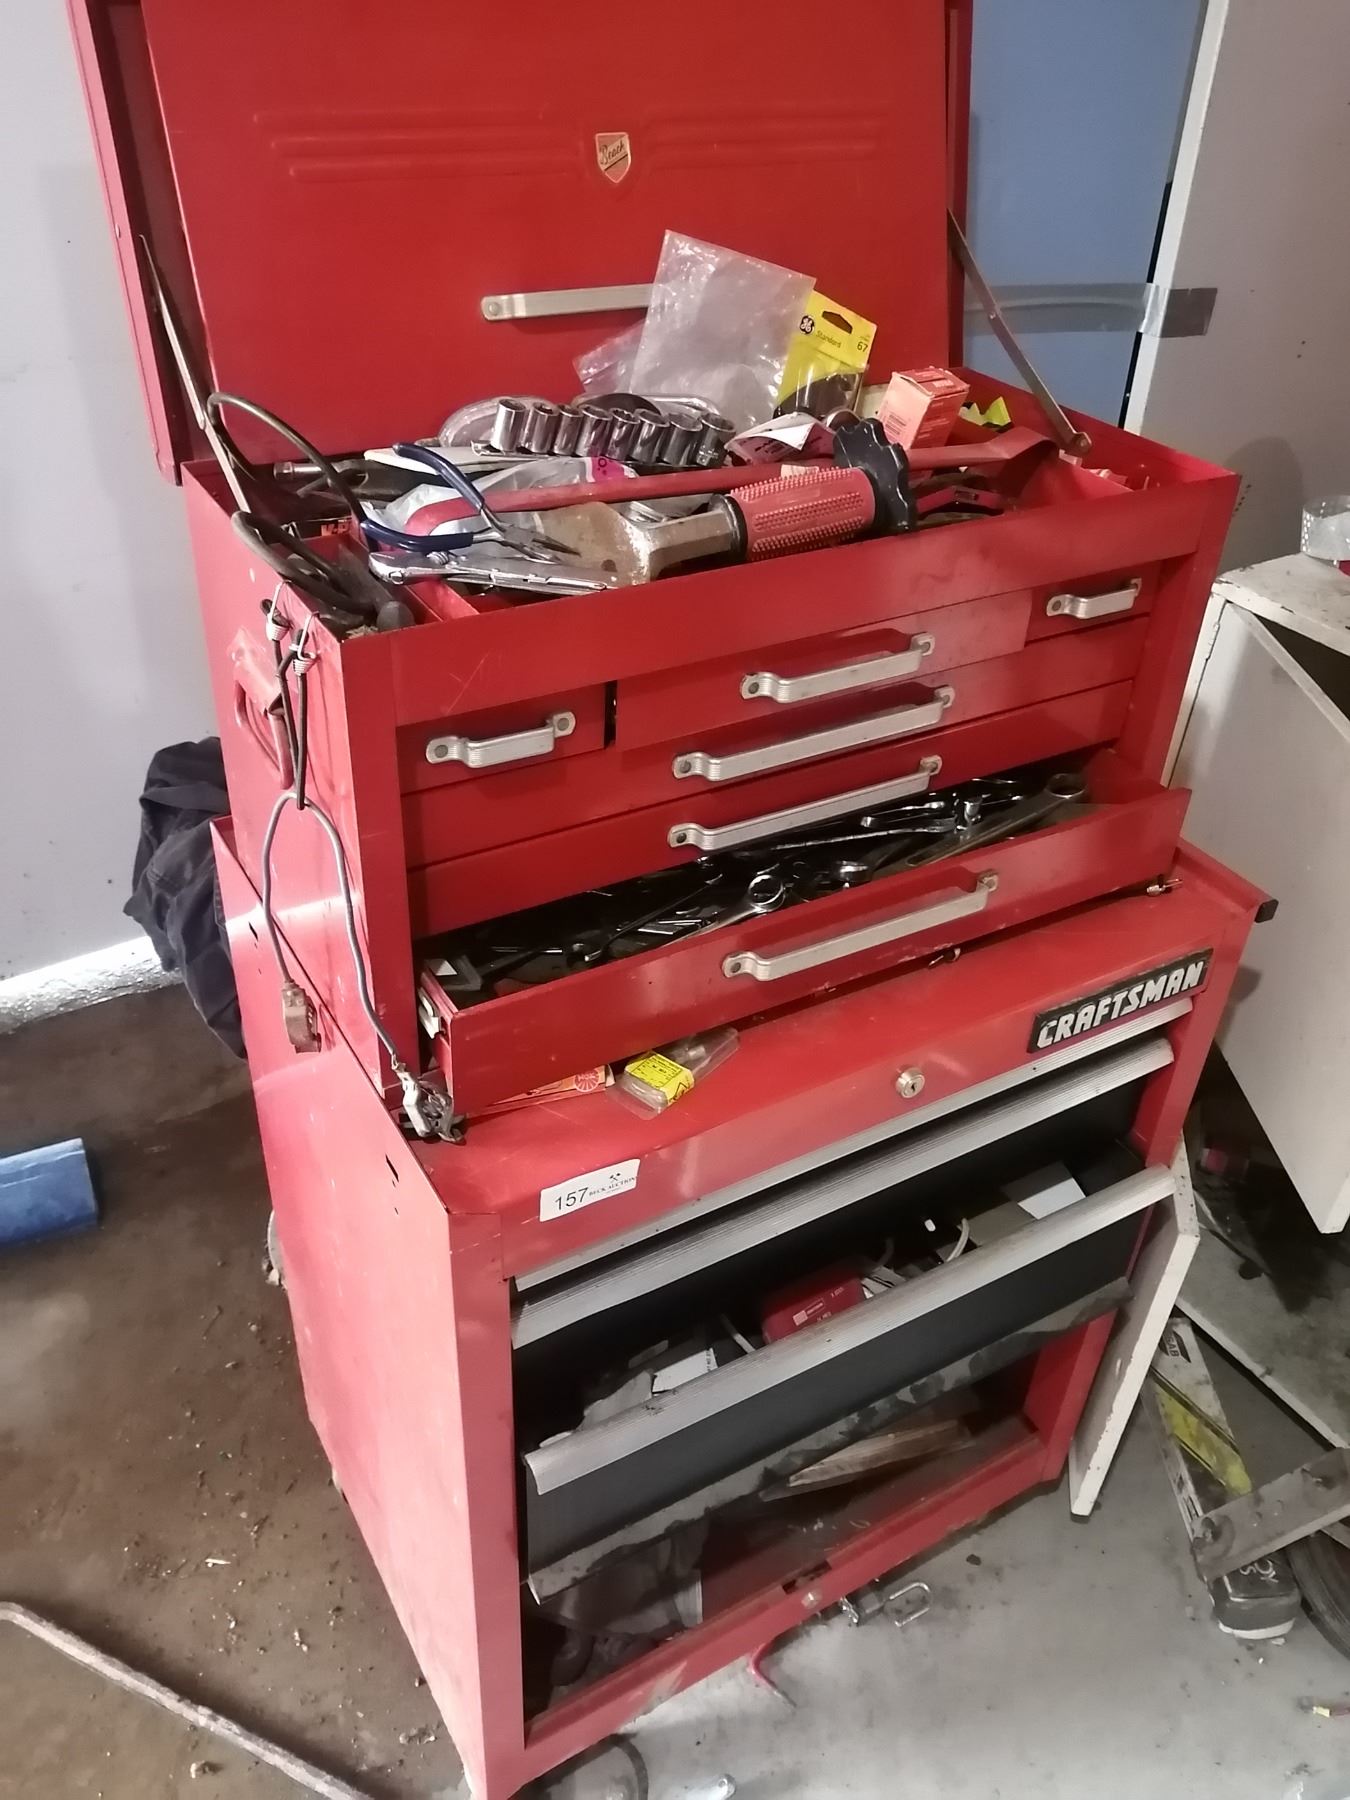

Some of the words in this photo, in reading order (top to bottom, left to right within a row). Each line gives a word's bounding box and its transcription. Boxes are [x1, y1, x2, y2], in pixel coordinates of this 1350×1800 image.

[857, 341, 869, 353] 67
[1036, 960, 1205, 1049] CRAFTSMAN
[554, 1187, 589, 1211] 157
